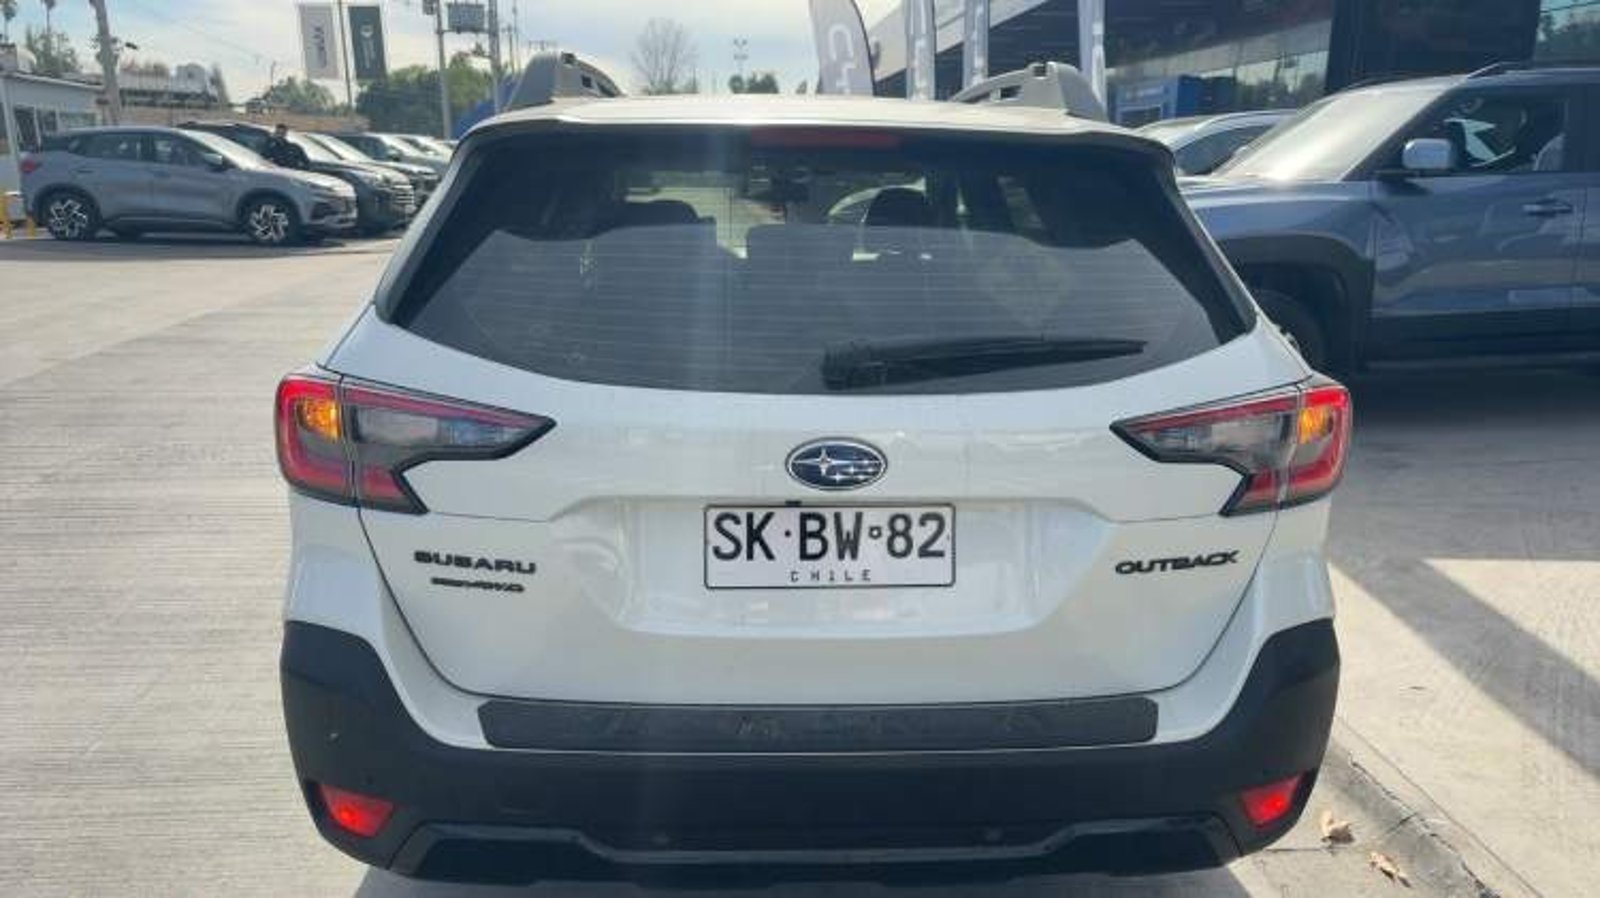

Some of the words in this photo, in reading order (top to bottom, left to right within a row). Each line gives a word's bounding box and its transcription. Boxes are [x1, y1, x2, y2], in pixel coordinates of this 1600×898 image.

[414, 551, 536, 574] SUBARU
[1115, 550, 1239, 575] OUTBACK
[790, 570, 872, 583] CHILE
